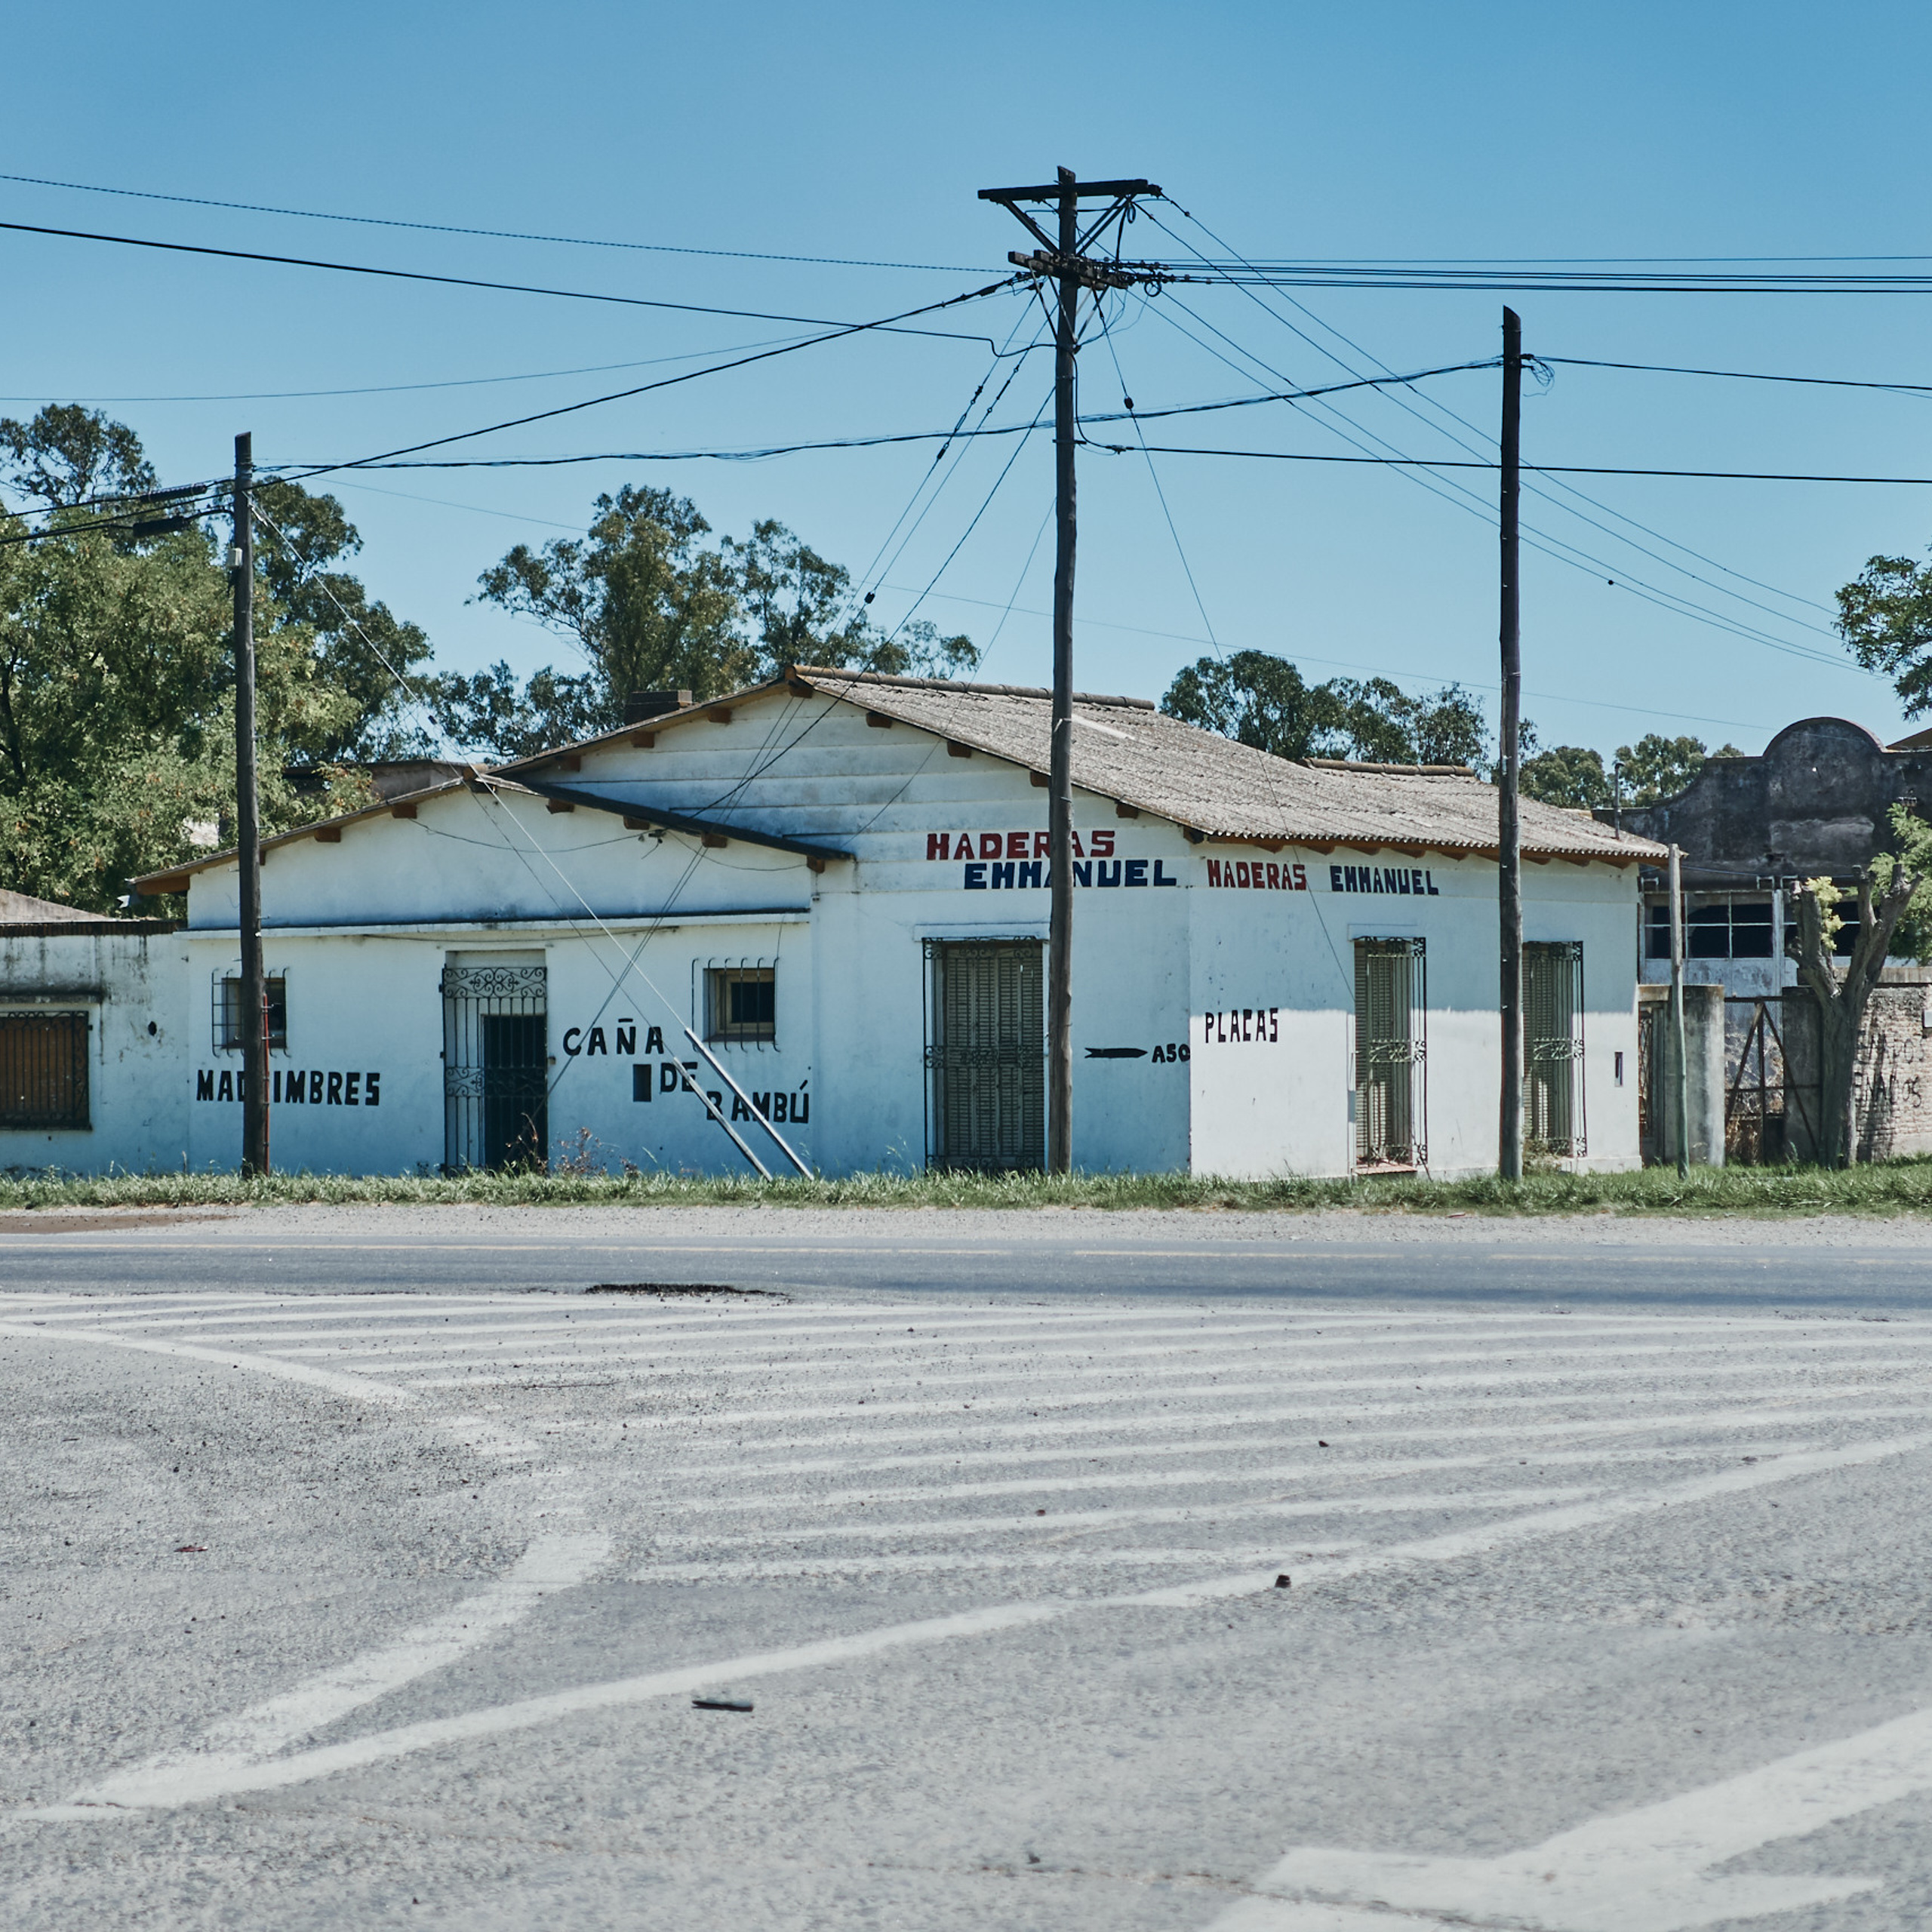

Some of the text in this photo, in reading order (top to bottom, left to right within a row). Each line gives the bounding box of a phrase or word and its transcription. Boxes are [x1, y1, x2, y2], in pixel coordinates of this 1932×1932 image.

[1207, 859, 1439, 896] MADERAS EMMANUEL
[563, 1018, 664, 1056] CAÑA
[1204, 1007, 1278, 1044] PLACAS
[196, 1069, 380, 1106] MAIMBRES
[660, 1061, 698, 1092] DE
[706, 1079, 810, 1124] BAMBÚ
